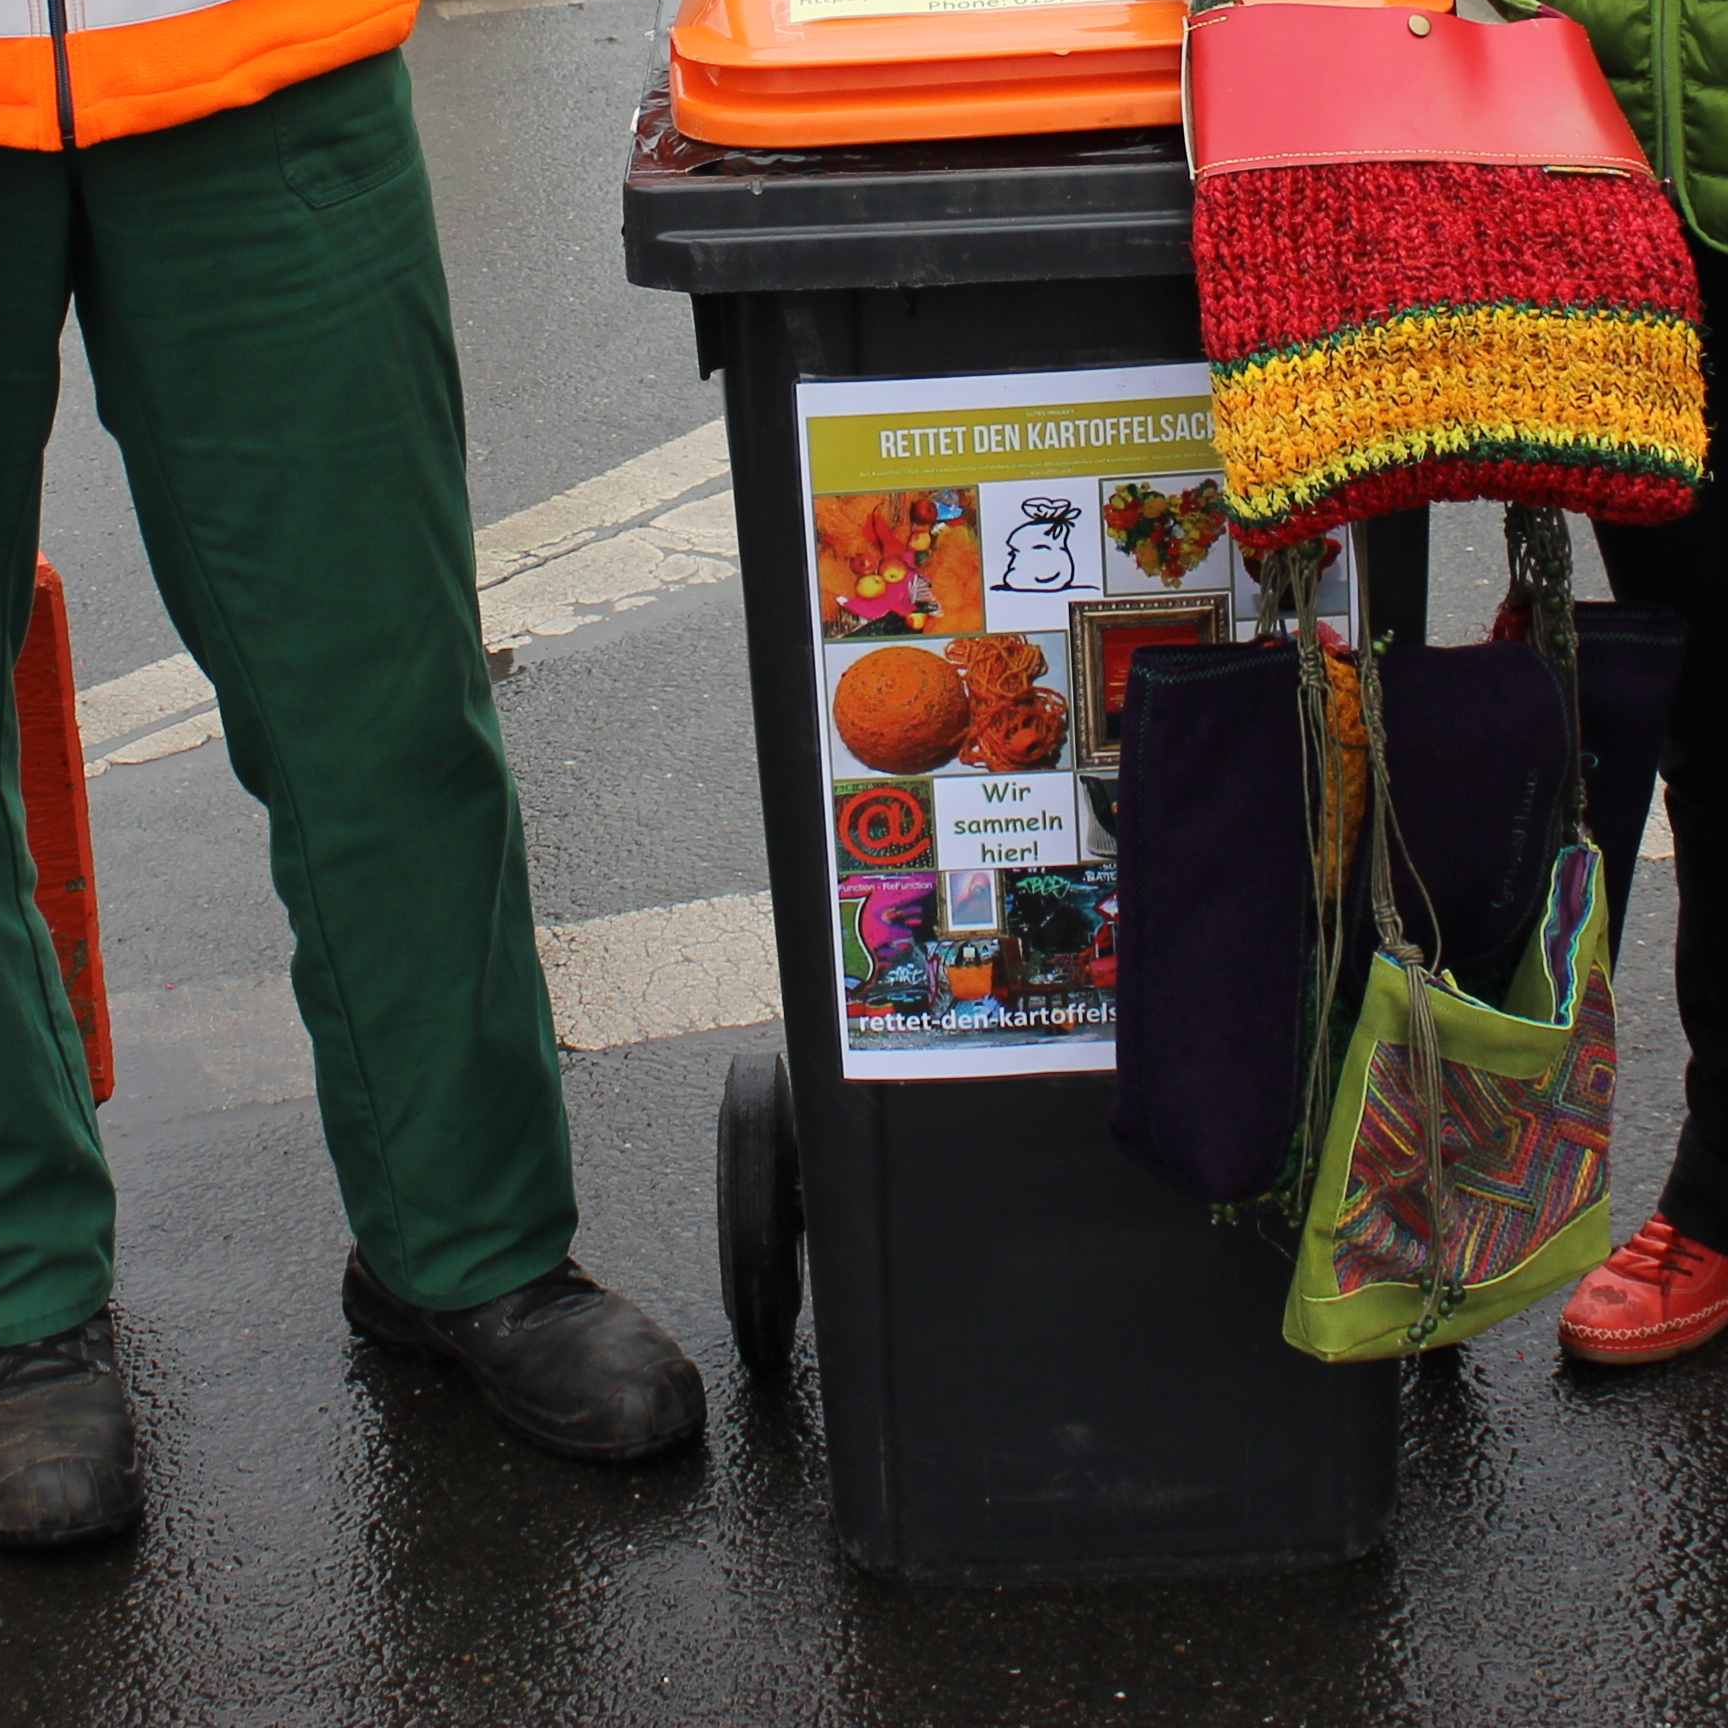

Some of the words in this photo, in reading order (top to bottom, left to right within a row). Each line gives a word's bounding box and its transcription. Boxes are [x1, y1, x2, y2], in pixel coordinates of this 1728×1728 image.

[880, 426, 967, 459] RETTET
[974, 422, 1021, 455] DEN
[981, 782, 1032, 804] Wir
[953, 811, 1064, 835] sammeln
[980, 841, 1039, 863] hier!
